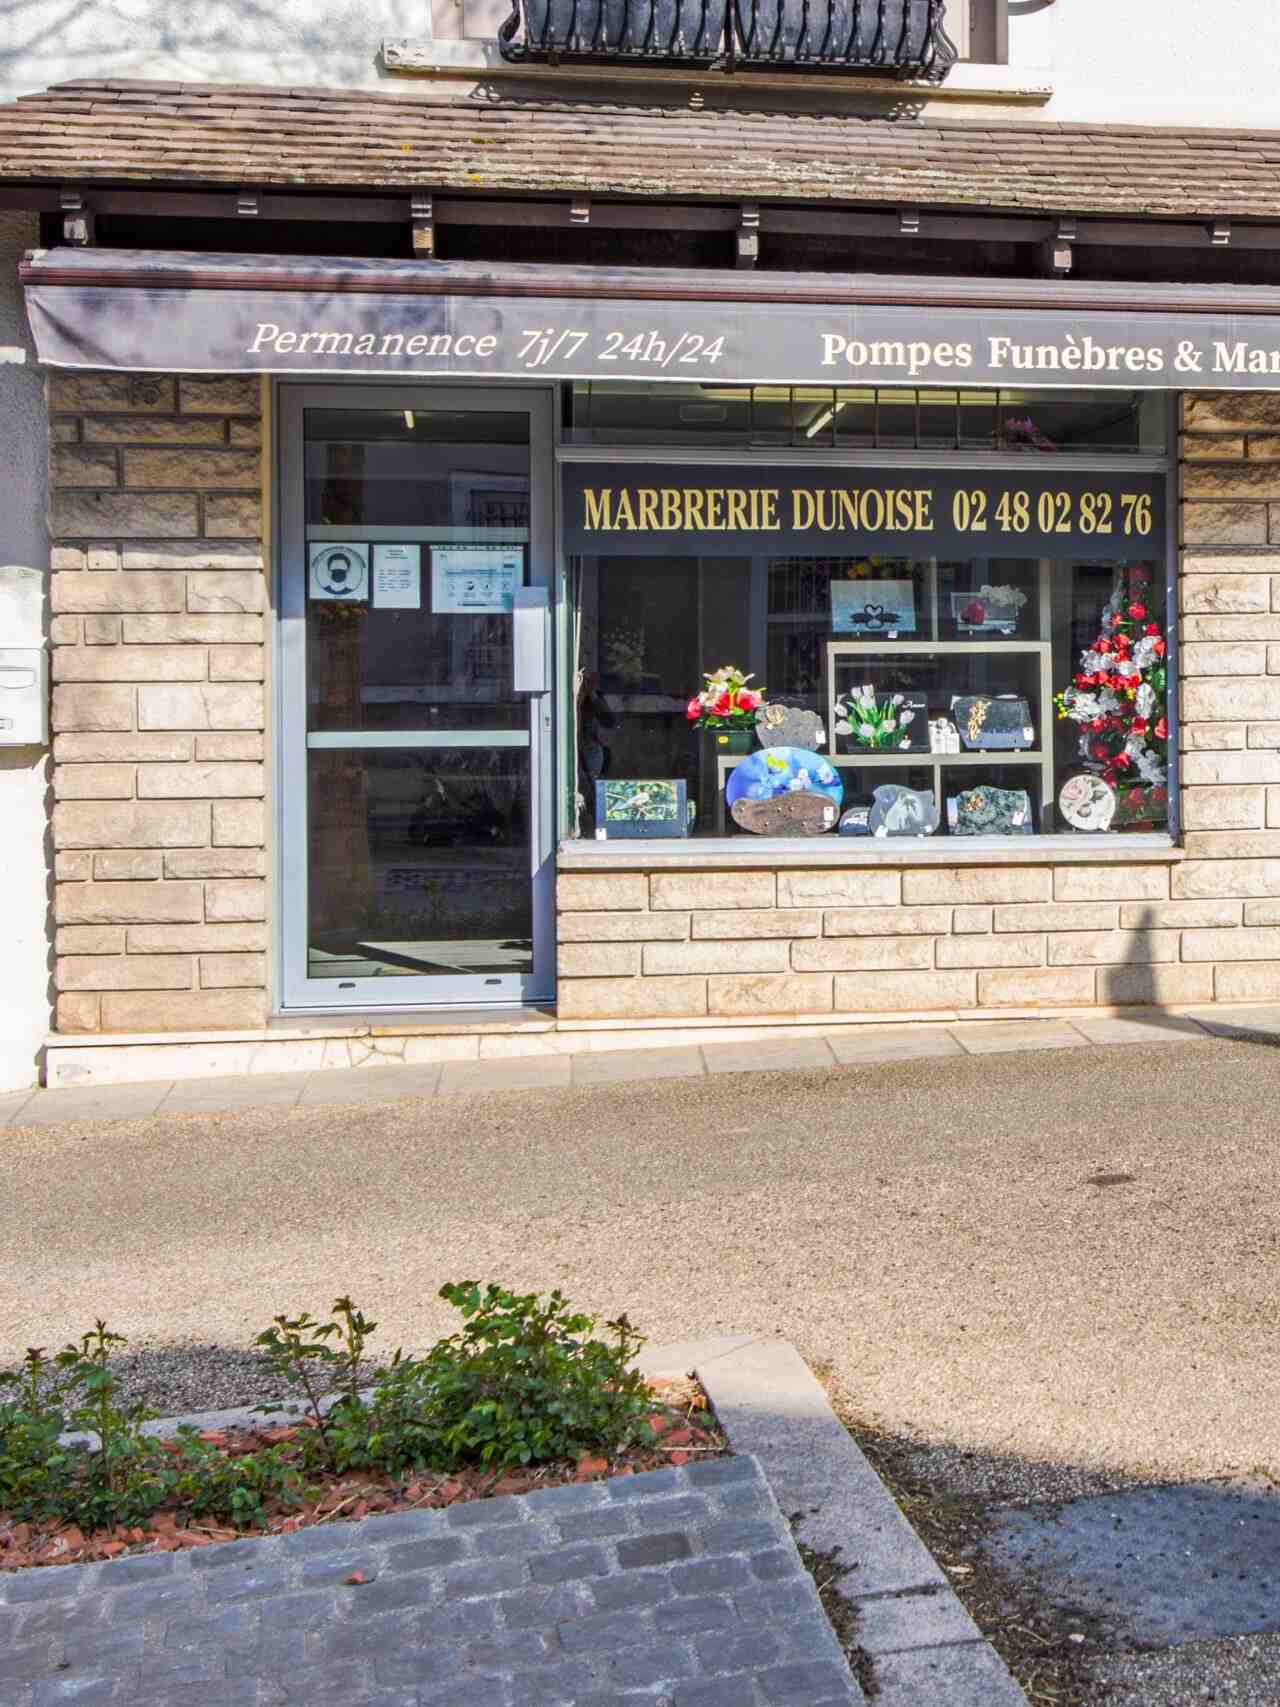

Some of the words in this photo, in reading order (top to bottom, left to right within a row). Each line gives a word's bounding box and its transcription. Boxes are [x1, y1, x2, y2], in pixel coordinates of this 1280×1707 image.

[247, 323, 498, 357] Permanence
[517, 327, 588, 368] 7j/7
[597, 329, 726, 368] 24h/24
[821, 333, 973, 376] Pompes
[988, 334, 1164, 373] Funèbres
[1174, 340, 1202, 372] &
[583, 488, 781, 531] MARBRERIE
[792, 489, 934, 531] DUNOISE
[952, 491, 987, 533] 02
[994, 492, 1031, 533] 48
[1037, 493, 1072, 534] 02
[1078, 493, 1112, 534] 82
[1120, 494, 1152, 535] 76
